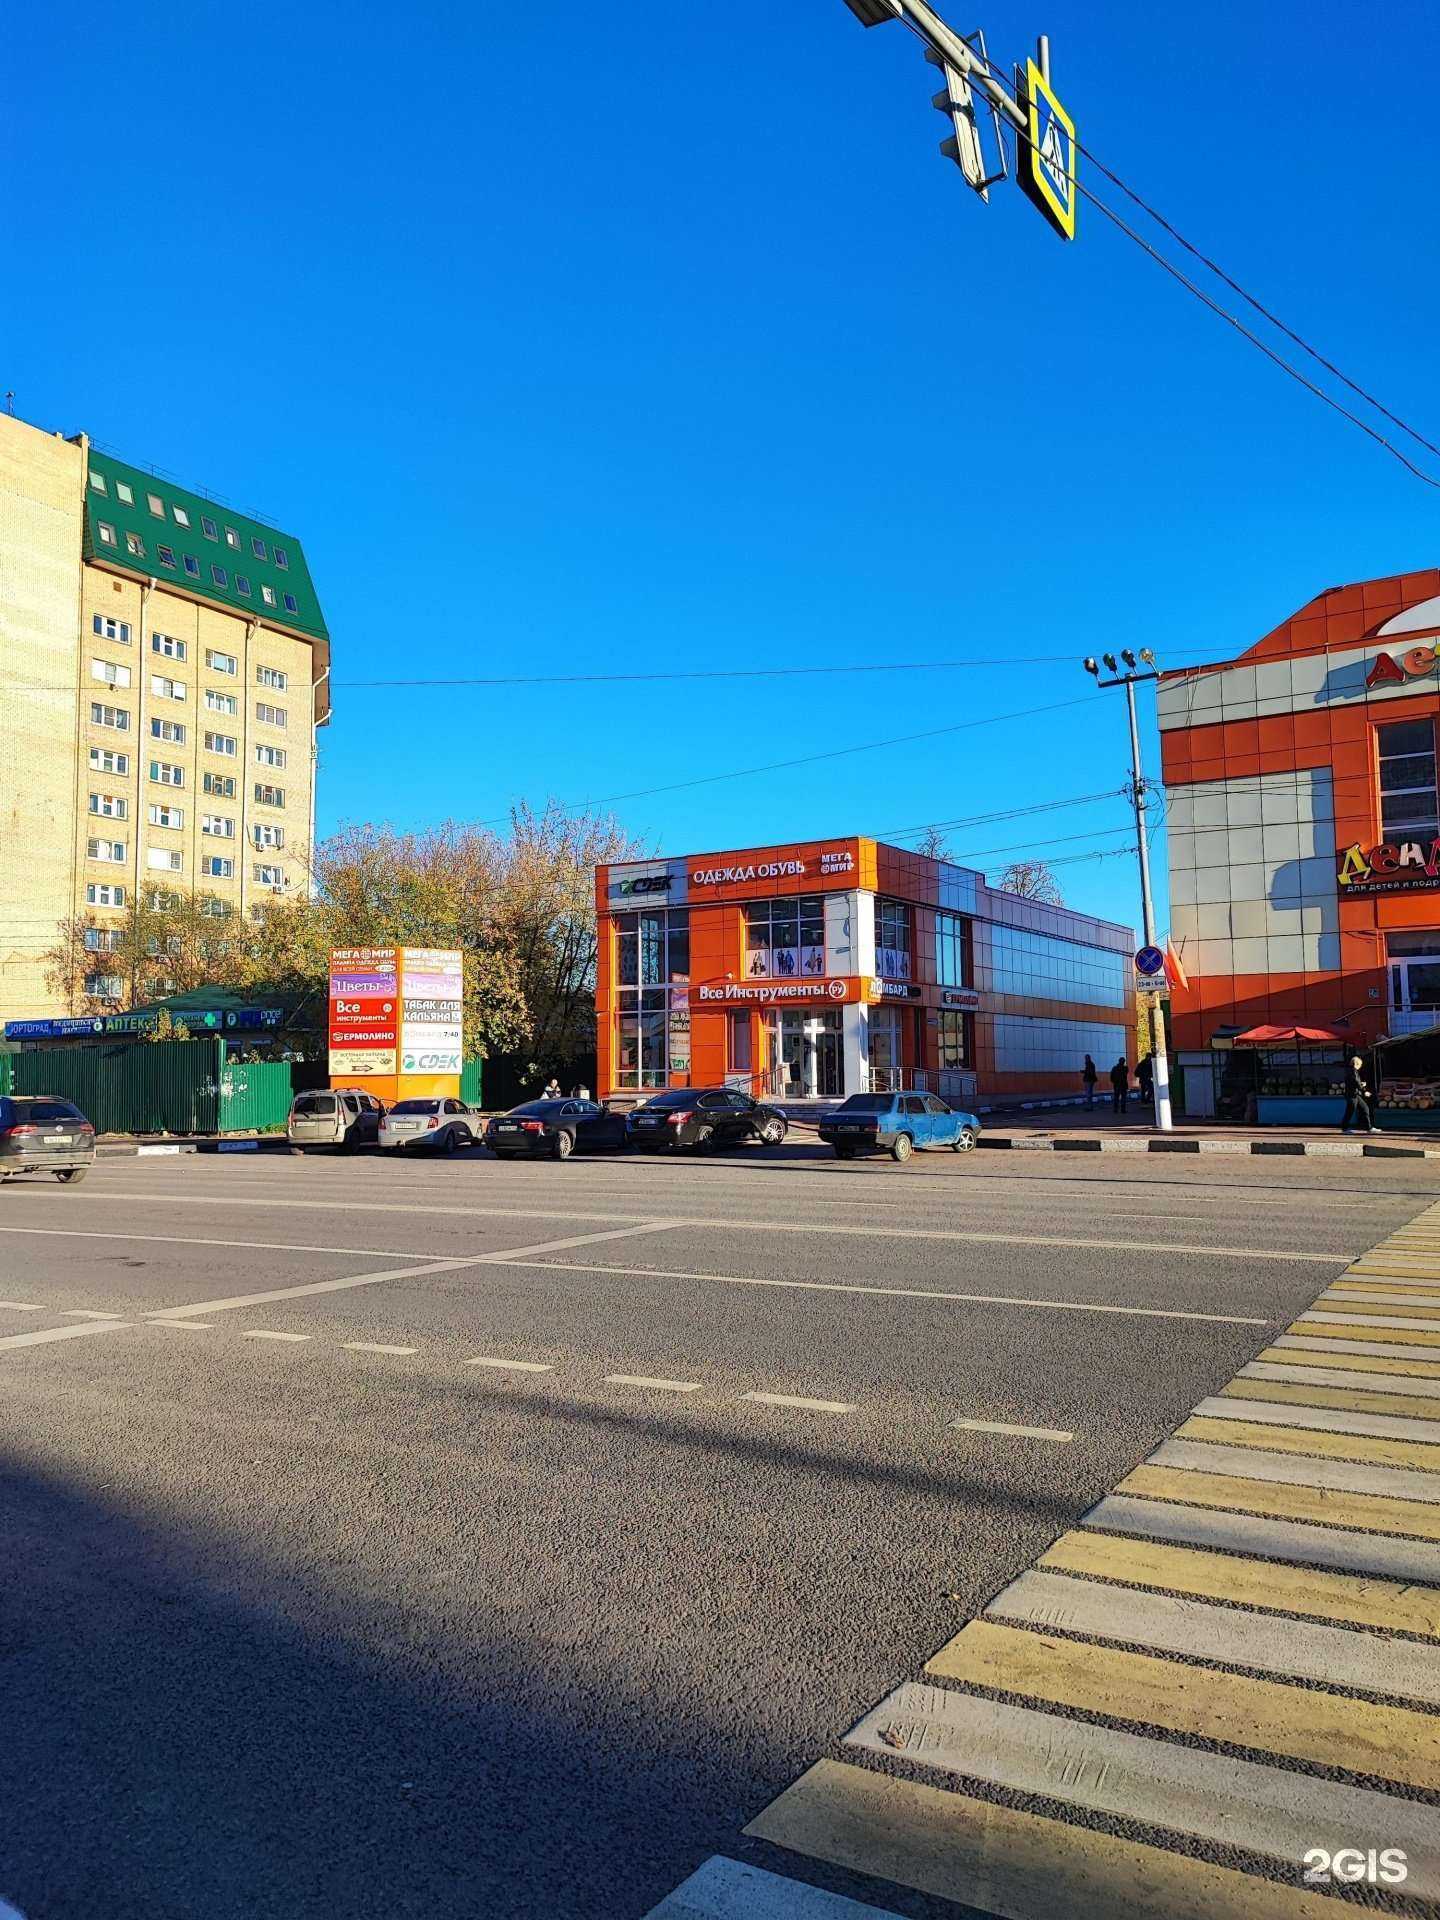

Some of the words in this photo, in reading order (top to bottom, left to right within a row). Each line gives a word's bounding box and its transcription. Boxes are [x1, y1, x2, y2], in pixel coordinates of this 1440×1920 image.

[821, 852, 852, 864] МЕГА
[693, 865, 755, 885] ОДЕЖДА
[757, 860, 805, 879] ОБУВЬ
[1369, 880, 1400, 891] детей
[332, 950, 360, 959] МЕГА
[371, 949, 395, 958] МИР
[336, 981, 381, 993] Цветы
[869, 979, 908, 997] ЛОМБАРД
[336, 1000, 360, 1013] Все
[404, 1000, 438, 1010] ТАБАК
[440, 1001, 460, 1011] ДЛЯ
[336, 1015, 387, 1023] инструменты
[404, 1011, 451, 1022] КАЛЬЯНА
[106, 1017, 154, 1031] АПТЕК
[344, 1032, 395, 1041] ЕРМОЛИНО
